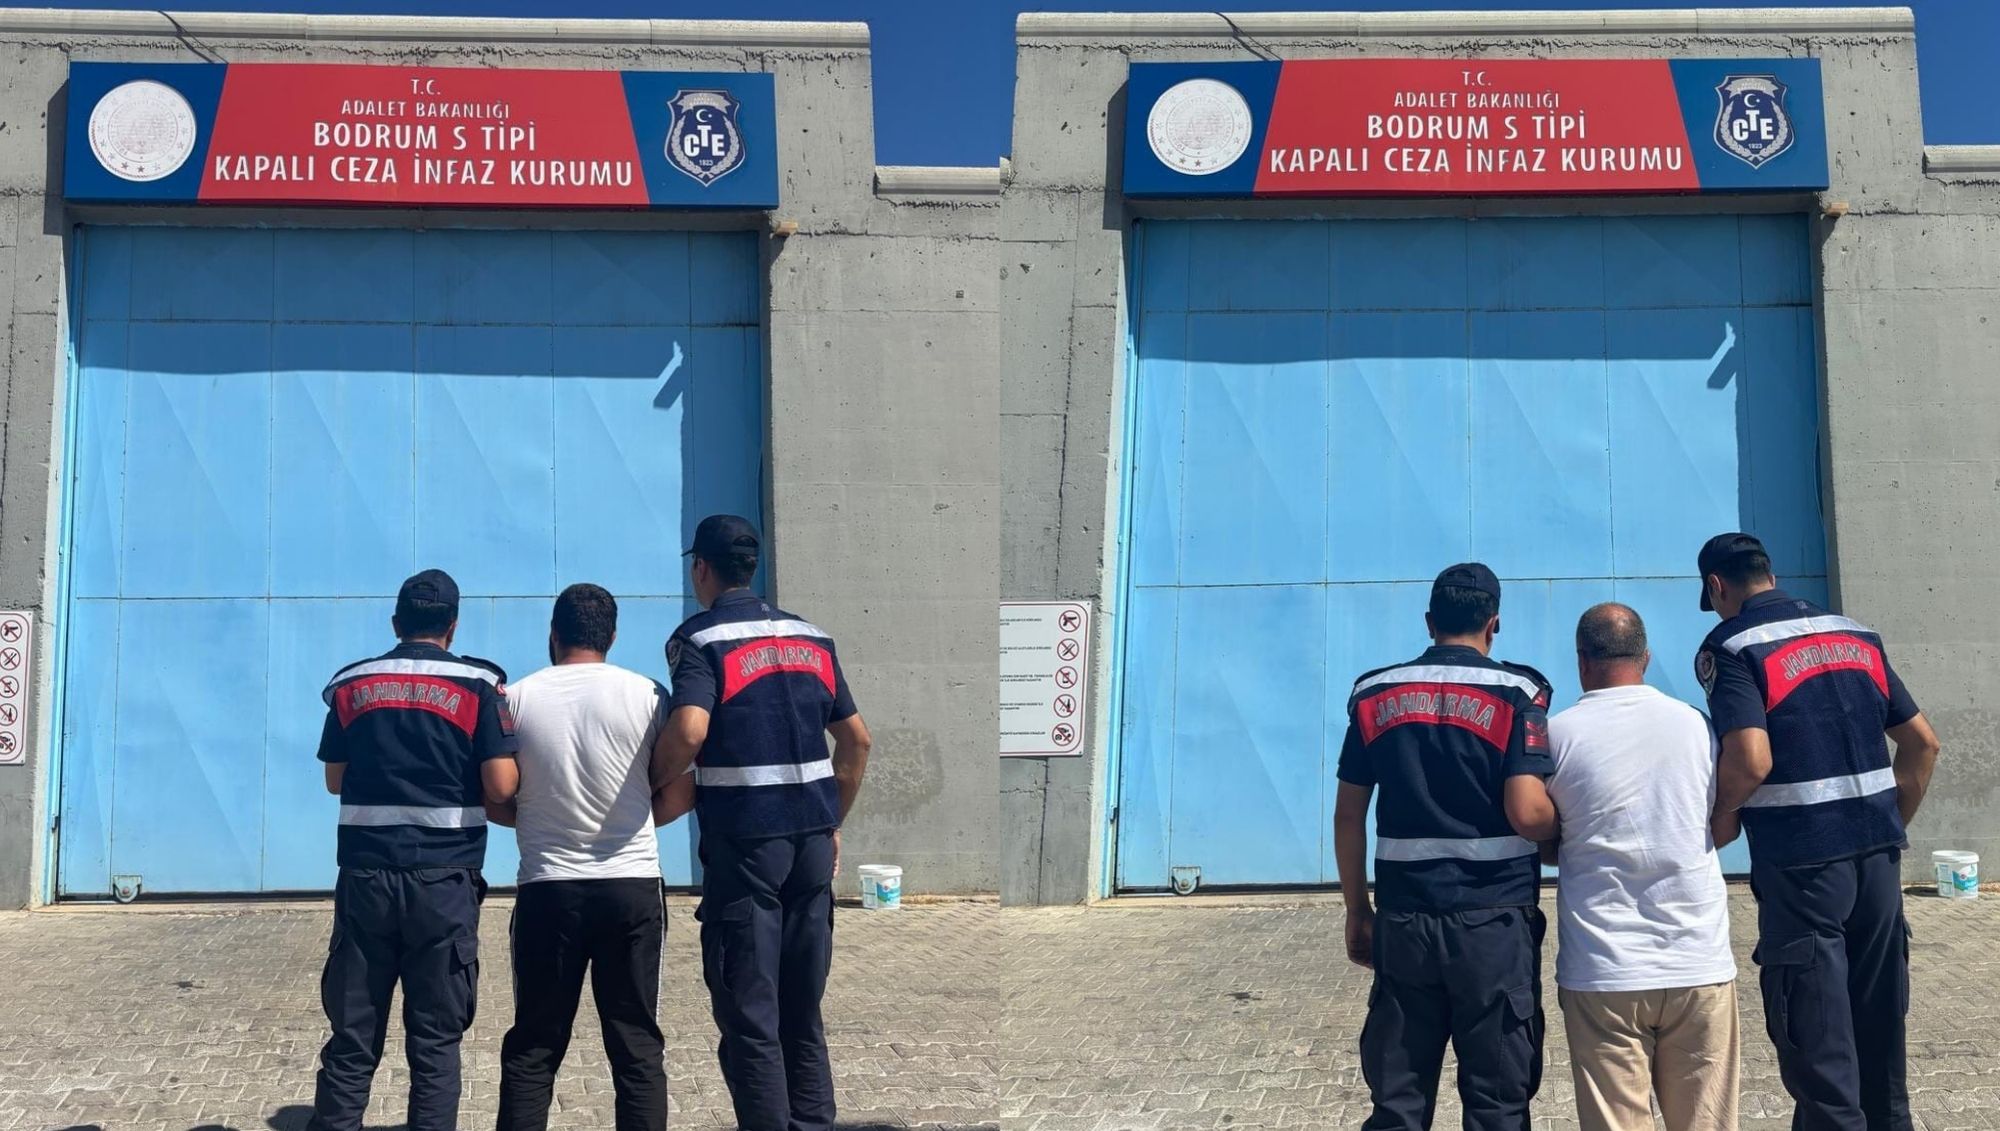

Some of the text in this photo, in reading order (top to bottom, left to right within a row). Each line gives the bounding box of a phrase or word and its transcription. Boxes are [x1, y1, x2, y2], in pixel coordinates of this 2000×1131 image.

[411, 79, 441, 95] T.C.
[1462, 71, 1491, 86] T.C.
[341, 99, 509, 119] ADALET BAKANLIĞI
[1394, 90, 1559, 108] ADALET BAKANLIĞI
[314, 120, 535, 151] BODRUM S TİPİ
[1367, 110, 1585, 140] BODRUM S TİPİ
[215, 152, 632, 187] KAPALI CEZA İNFAZ KURUMU
[1271, 142, 1682, 173] KAPALI CEZA İNFAZ KURUMU
[740, 645, 822, 676] JANDARMA
[1780, 643, 1873, 680] JANDARMA
[352, 682, 461, 714] JANDARMA
[1375, 691, 1495, 729] JANDARMA
